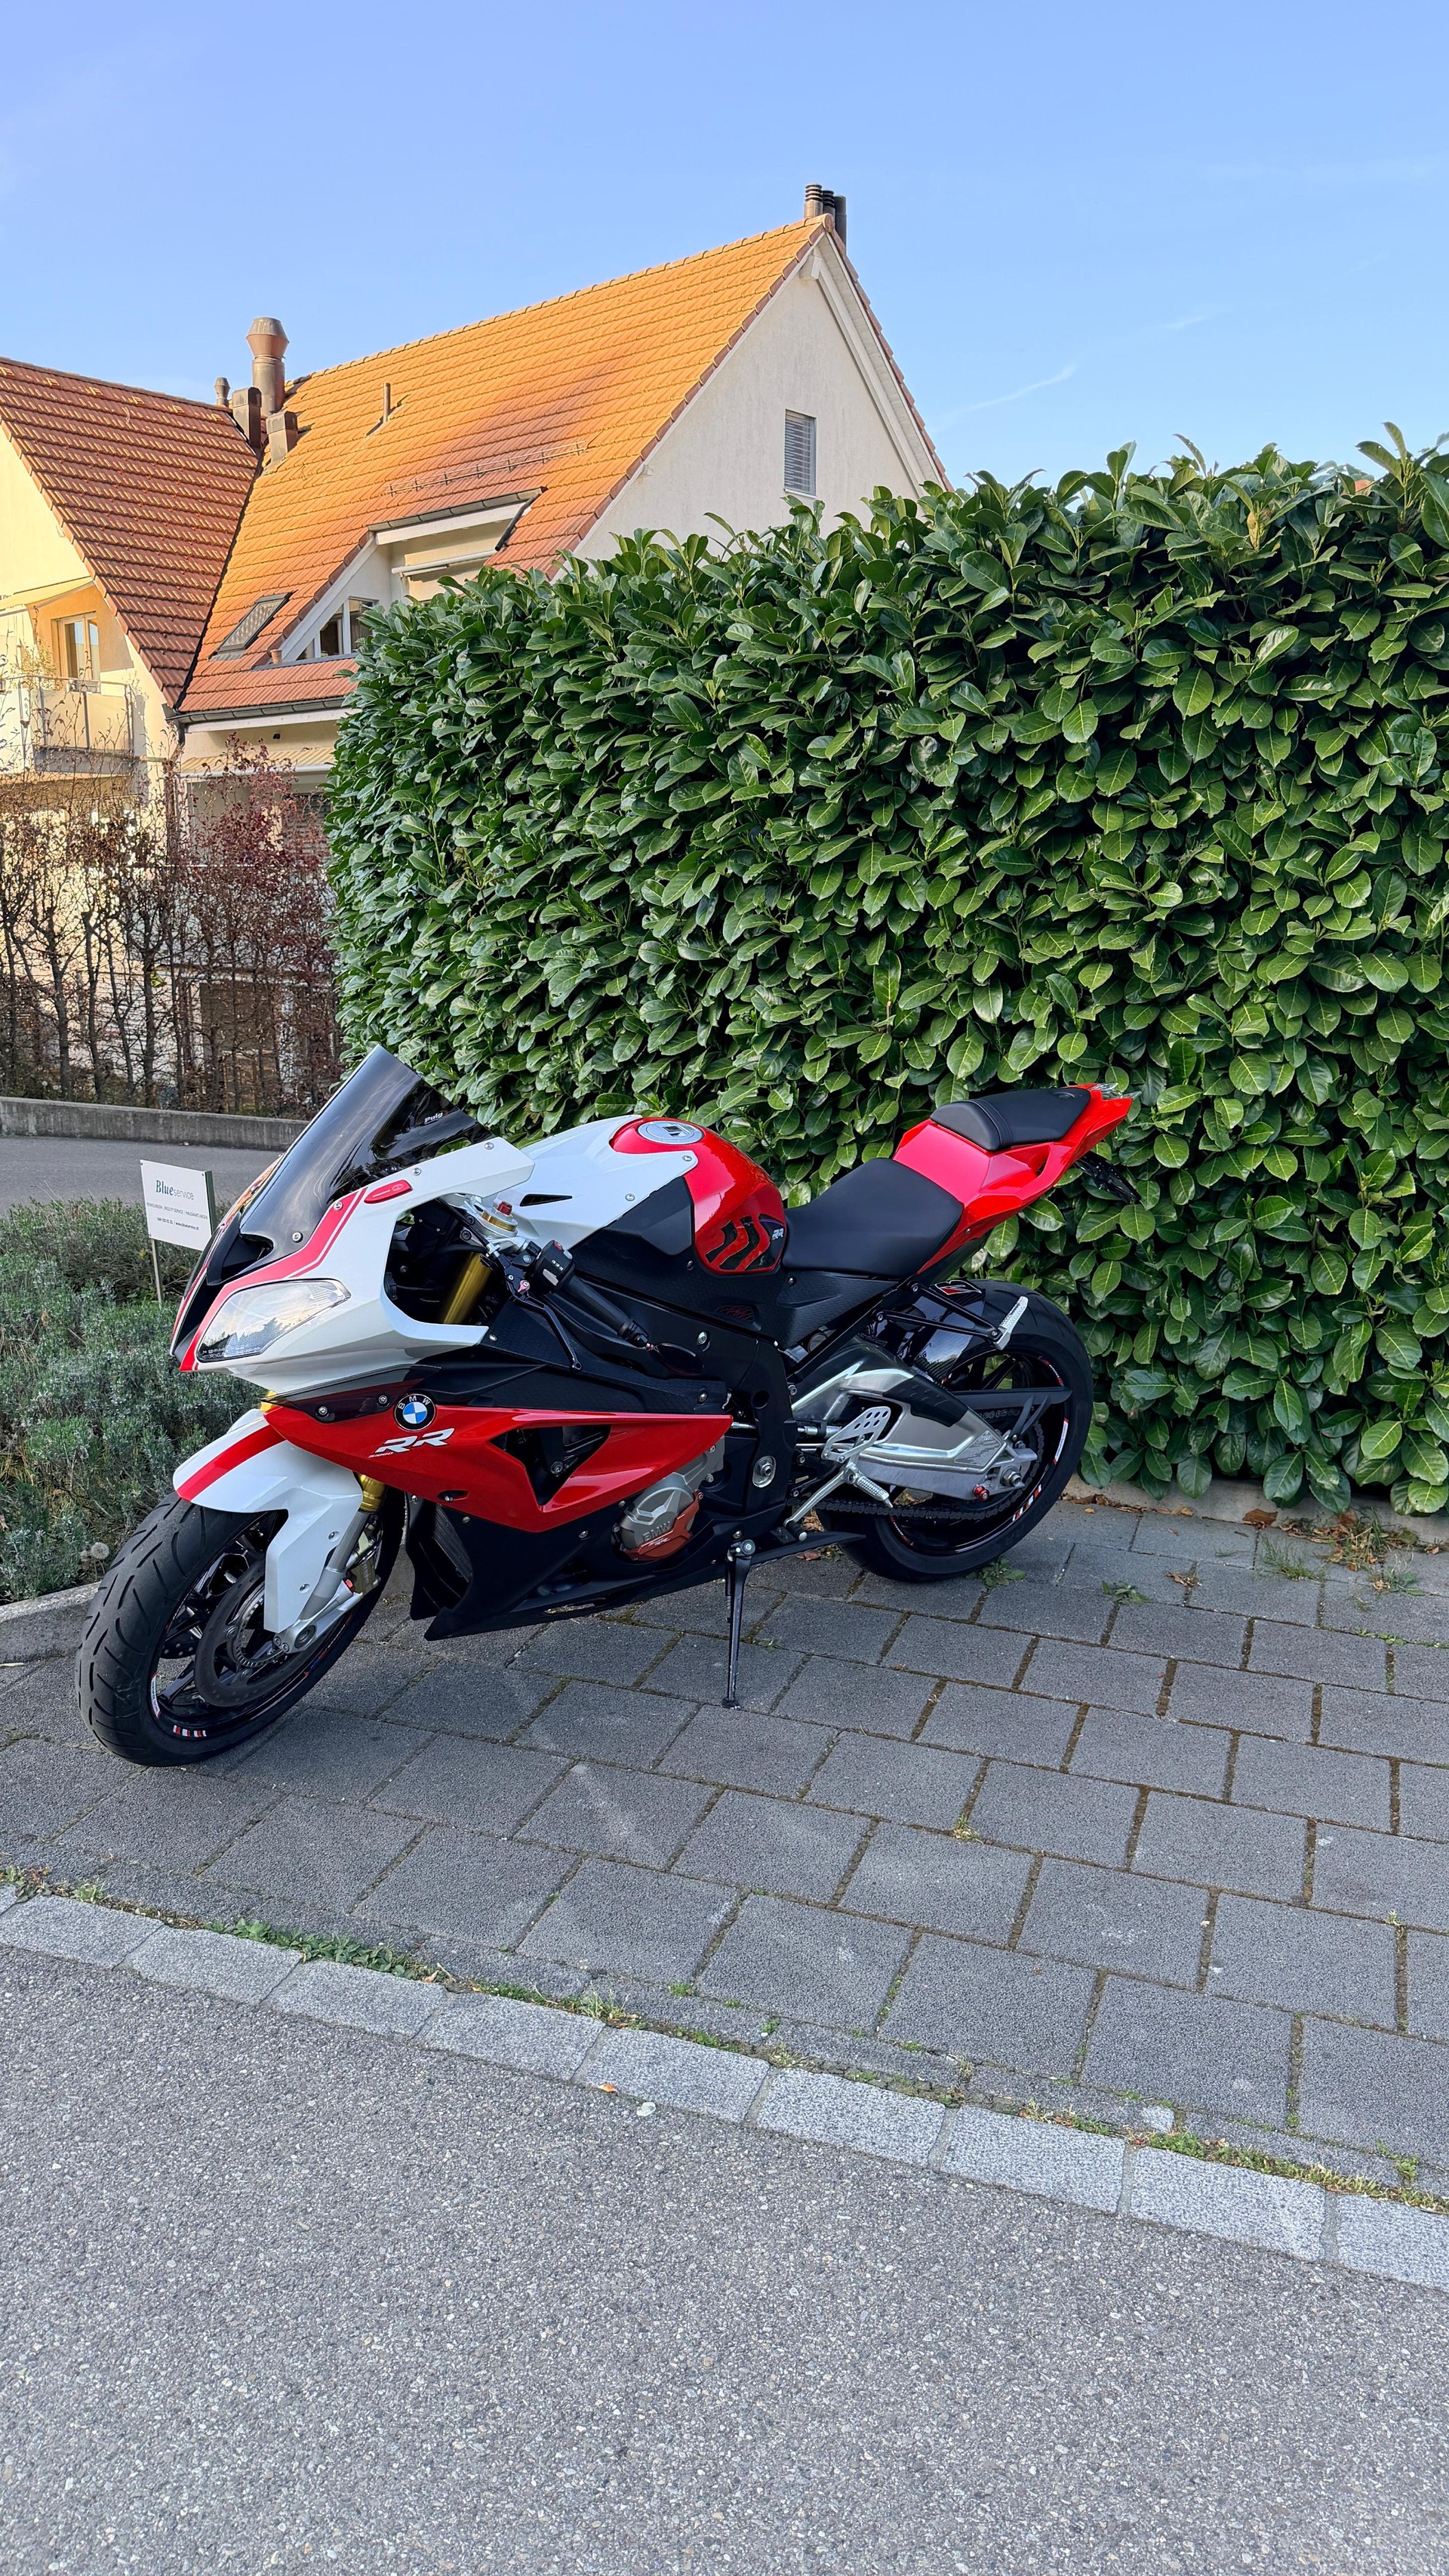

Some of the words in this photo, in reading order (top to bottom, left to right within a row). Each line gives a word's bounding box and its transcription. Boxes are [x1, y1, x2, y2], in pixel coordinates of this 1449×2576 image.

[424, 1112, 443, 1123] Puig
[155, 1180, 195, 1200] Blueservice
[398, 1395, 431, 1410] BMW
[374, 1427, 455, 1453] RR
[642, 1521, 670, 1542] BMW
